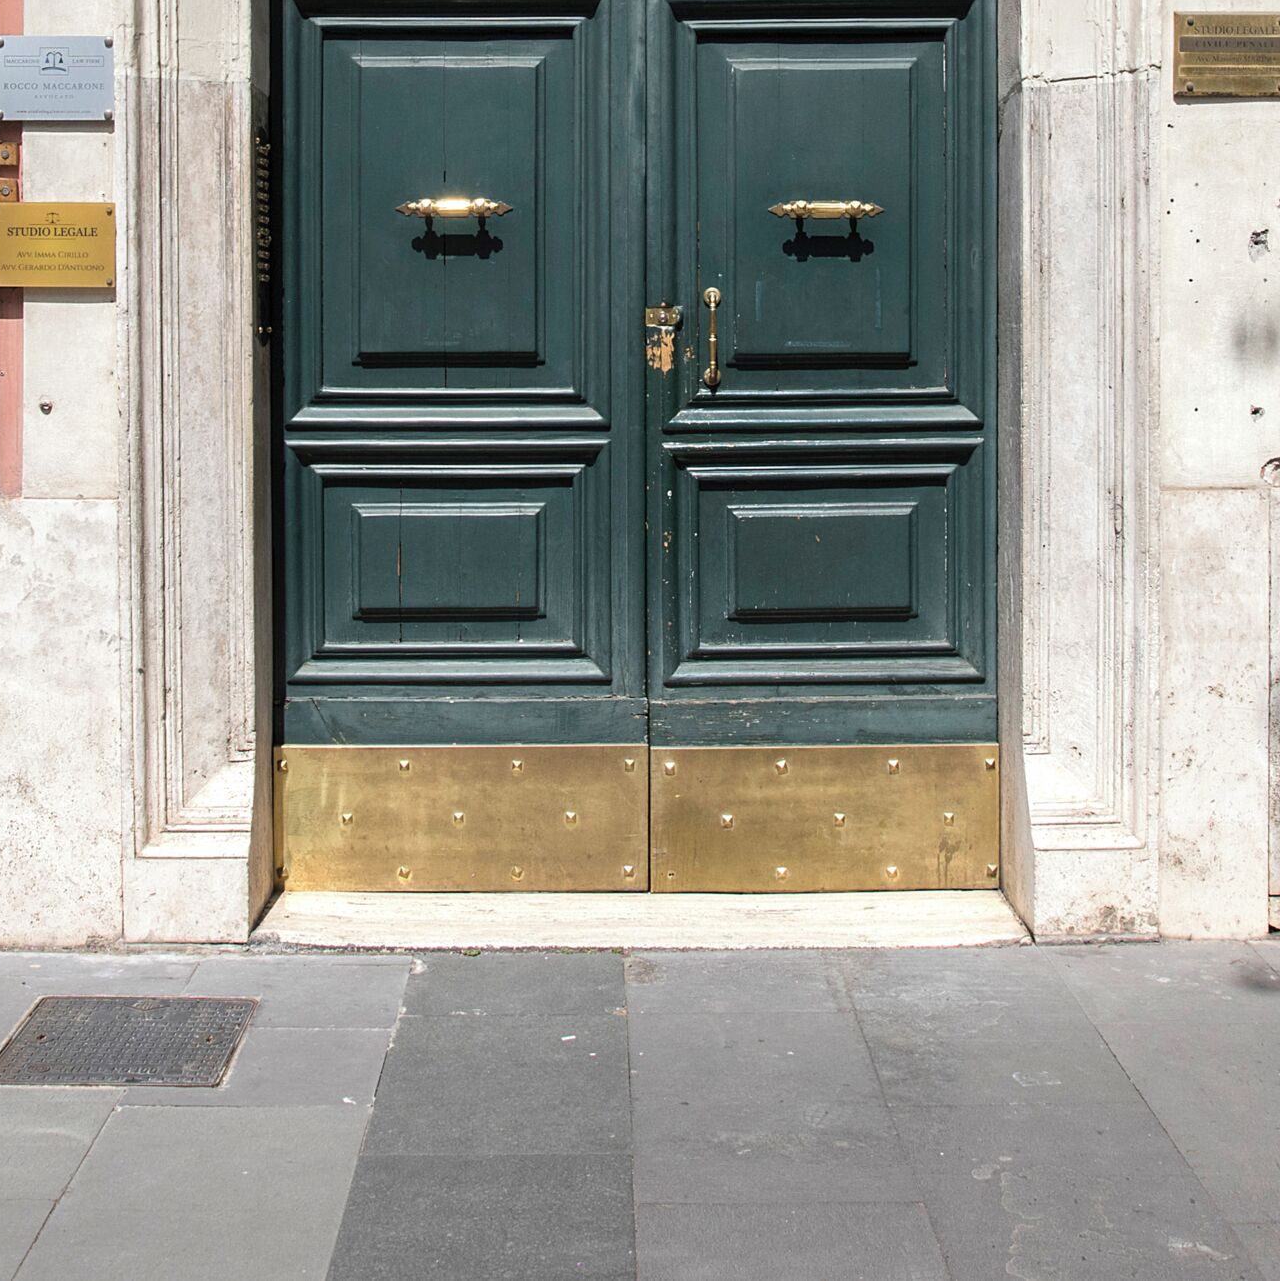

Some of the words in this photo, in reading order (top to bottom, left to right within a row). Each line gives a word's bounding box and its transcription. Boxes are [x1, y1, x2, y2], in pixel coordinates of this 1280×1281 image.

[1194, 25, 1234, 35] STUDIO
[1236, 25, 1278, 35] LEGALE
[3, 82, 39, 91] ROCCO
[43, 82, 105, 91] MACCARONE
[7, 227, 51, 237] STUDIO
[54, 227, 98, 237] LEGALE
